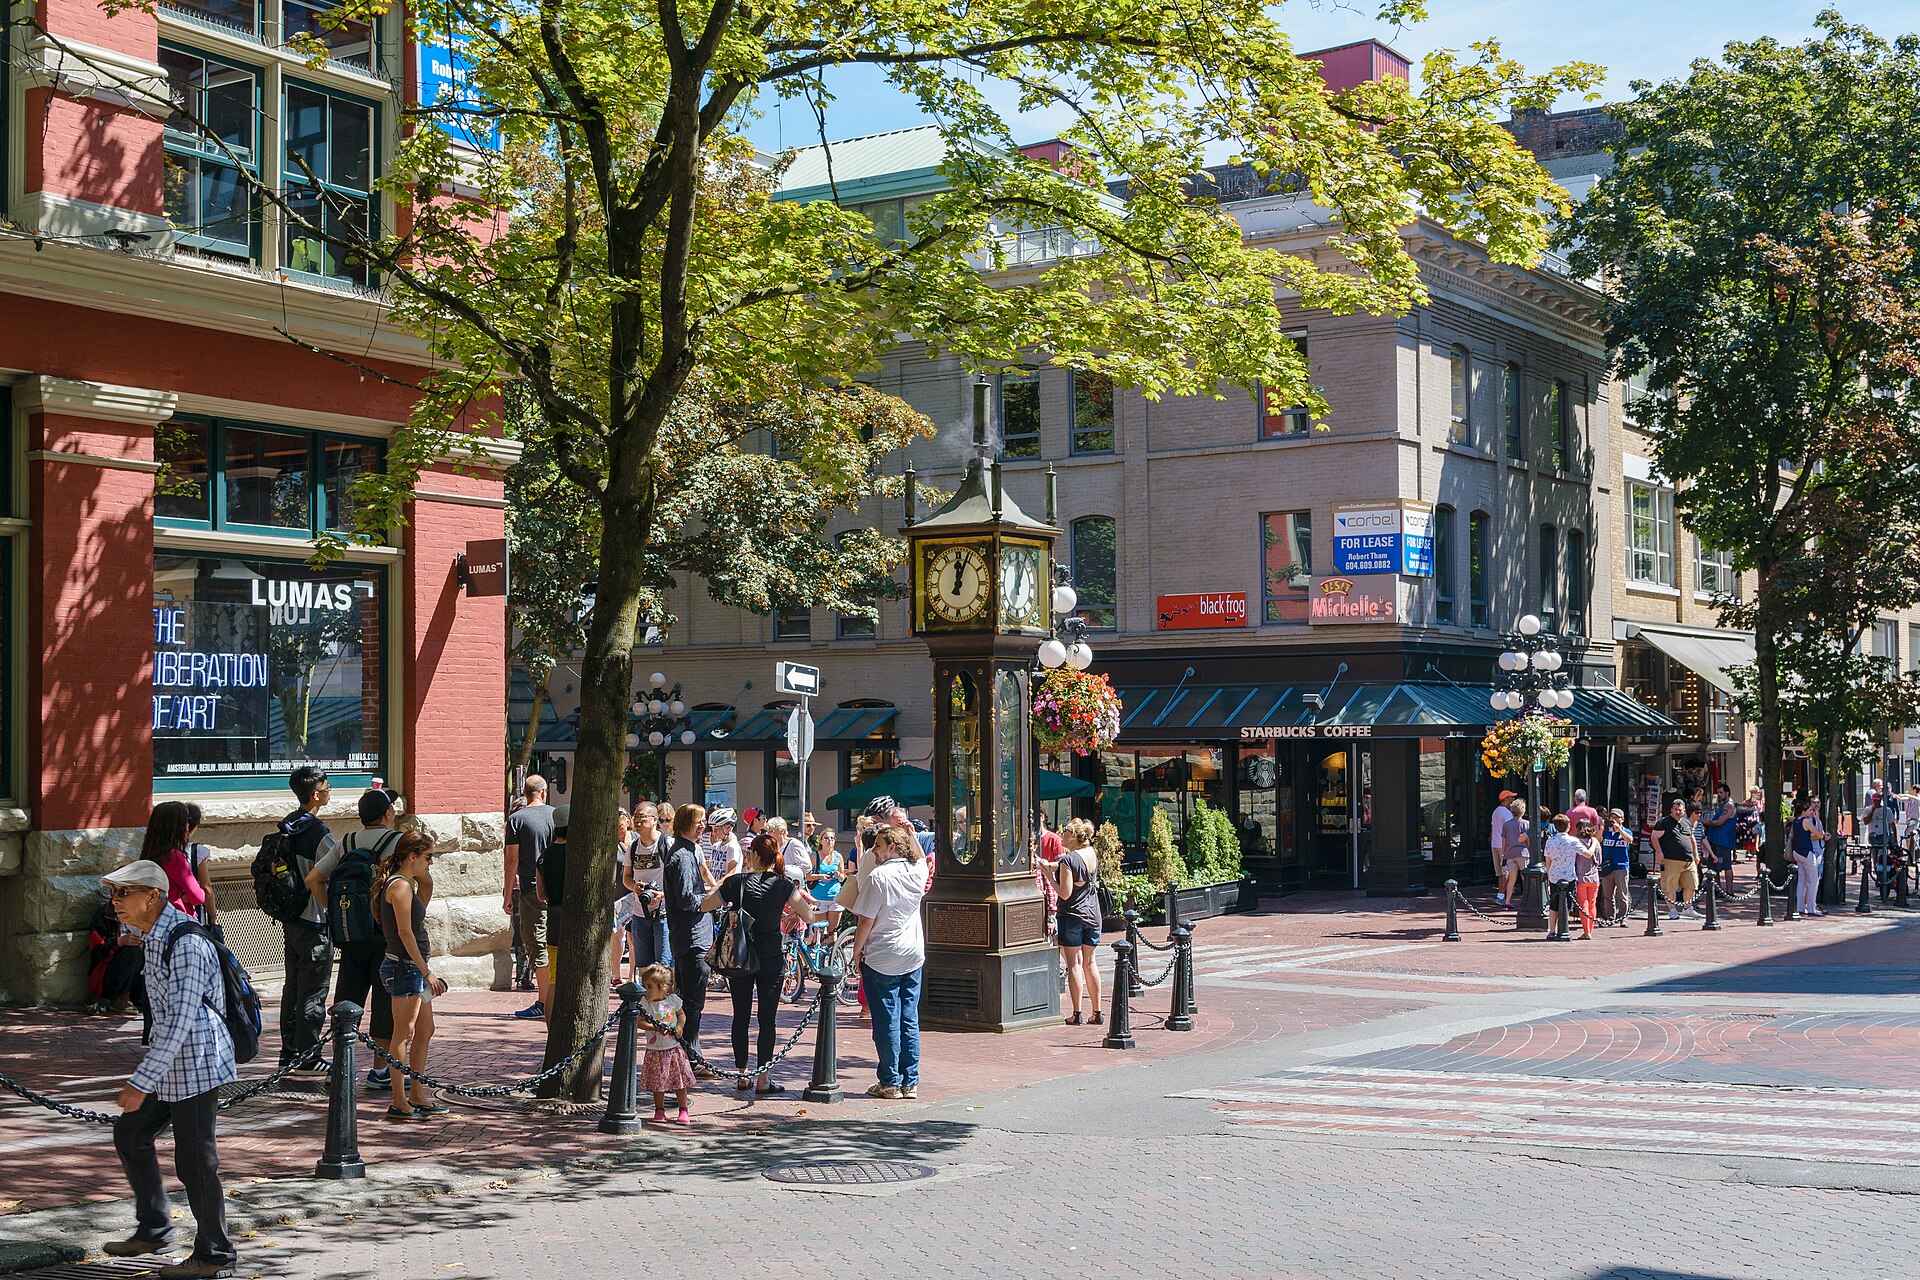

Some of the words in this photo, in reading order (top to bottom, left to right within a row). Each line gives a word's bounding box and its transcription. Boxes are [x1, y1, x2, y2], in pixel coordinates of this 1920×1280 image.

[1347, 513, 1395, 528] corbel
[1341, 538, 1360, 549] FOR
[1363, 536, 1394, 548] LEASE
[1406, 536, 1416, 548] FOR
[1348, 553, 1370, 561] Robert
[1370, 552, 1388, 560] Tham
[469, 564, 497, 574] LUMAS
[1321, 580, 1352, 593] VISIT
[252, 579, 352, 611] LUMAS
[1200, 595, 1224, 614] black
[1226, 594, 1245, 618] frog
[1312, 595, 1393, 618] Michelle's
[153, 608, 186, 645] HE
[177, 694, 222, 730] ART
[1240, 726, 1316, 738] STARBUCKS
[1323, 726, 1372, 737] COFFEE
[349, 752, 379, 761] LUMAS.COM
